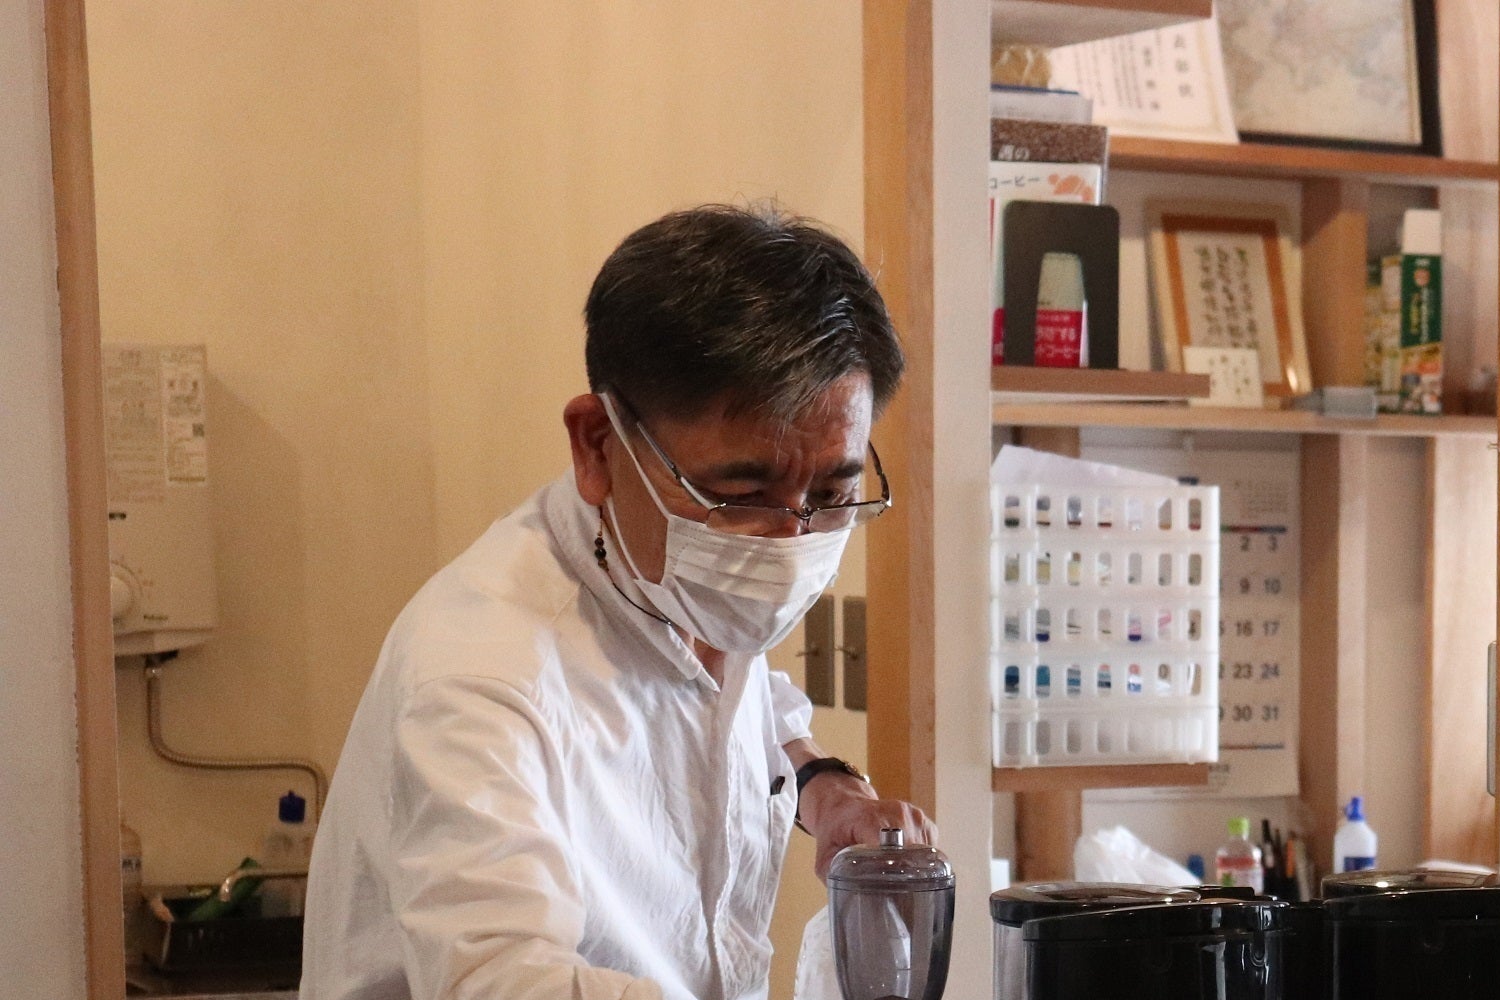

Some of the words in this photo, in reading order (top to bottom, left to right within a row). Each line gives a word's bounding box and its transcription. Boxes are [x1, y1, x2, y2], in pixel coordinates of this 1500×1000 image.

[1241, 537, 1249, 551] 2
[1269, 536, 1277, 551] 3
[1240, 578, 1249, 594] 9
[1264, 578, 1281, 594] 10
[1236, 621, 1252, 637] 16
[1263, 621, 1279, 636] 17
[1232, 664, 1252, 680] 23
[1261, 664, 1279, 680] 24
[1232, 706, 1251, 722] 30
[1262, 705, 1279, 722] 31
